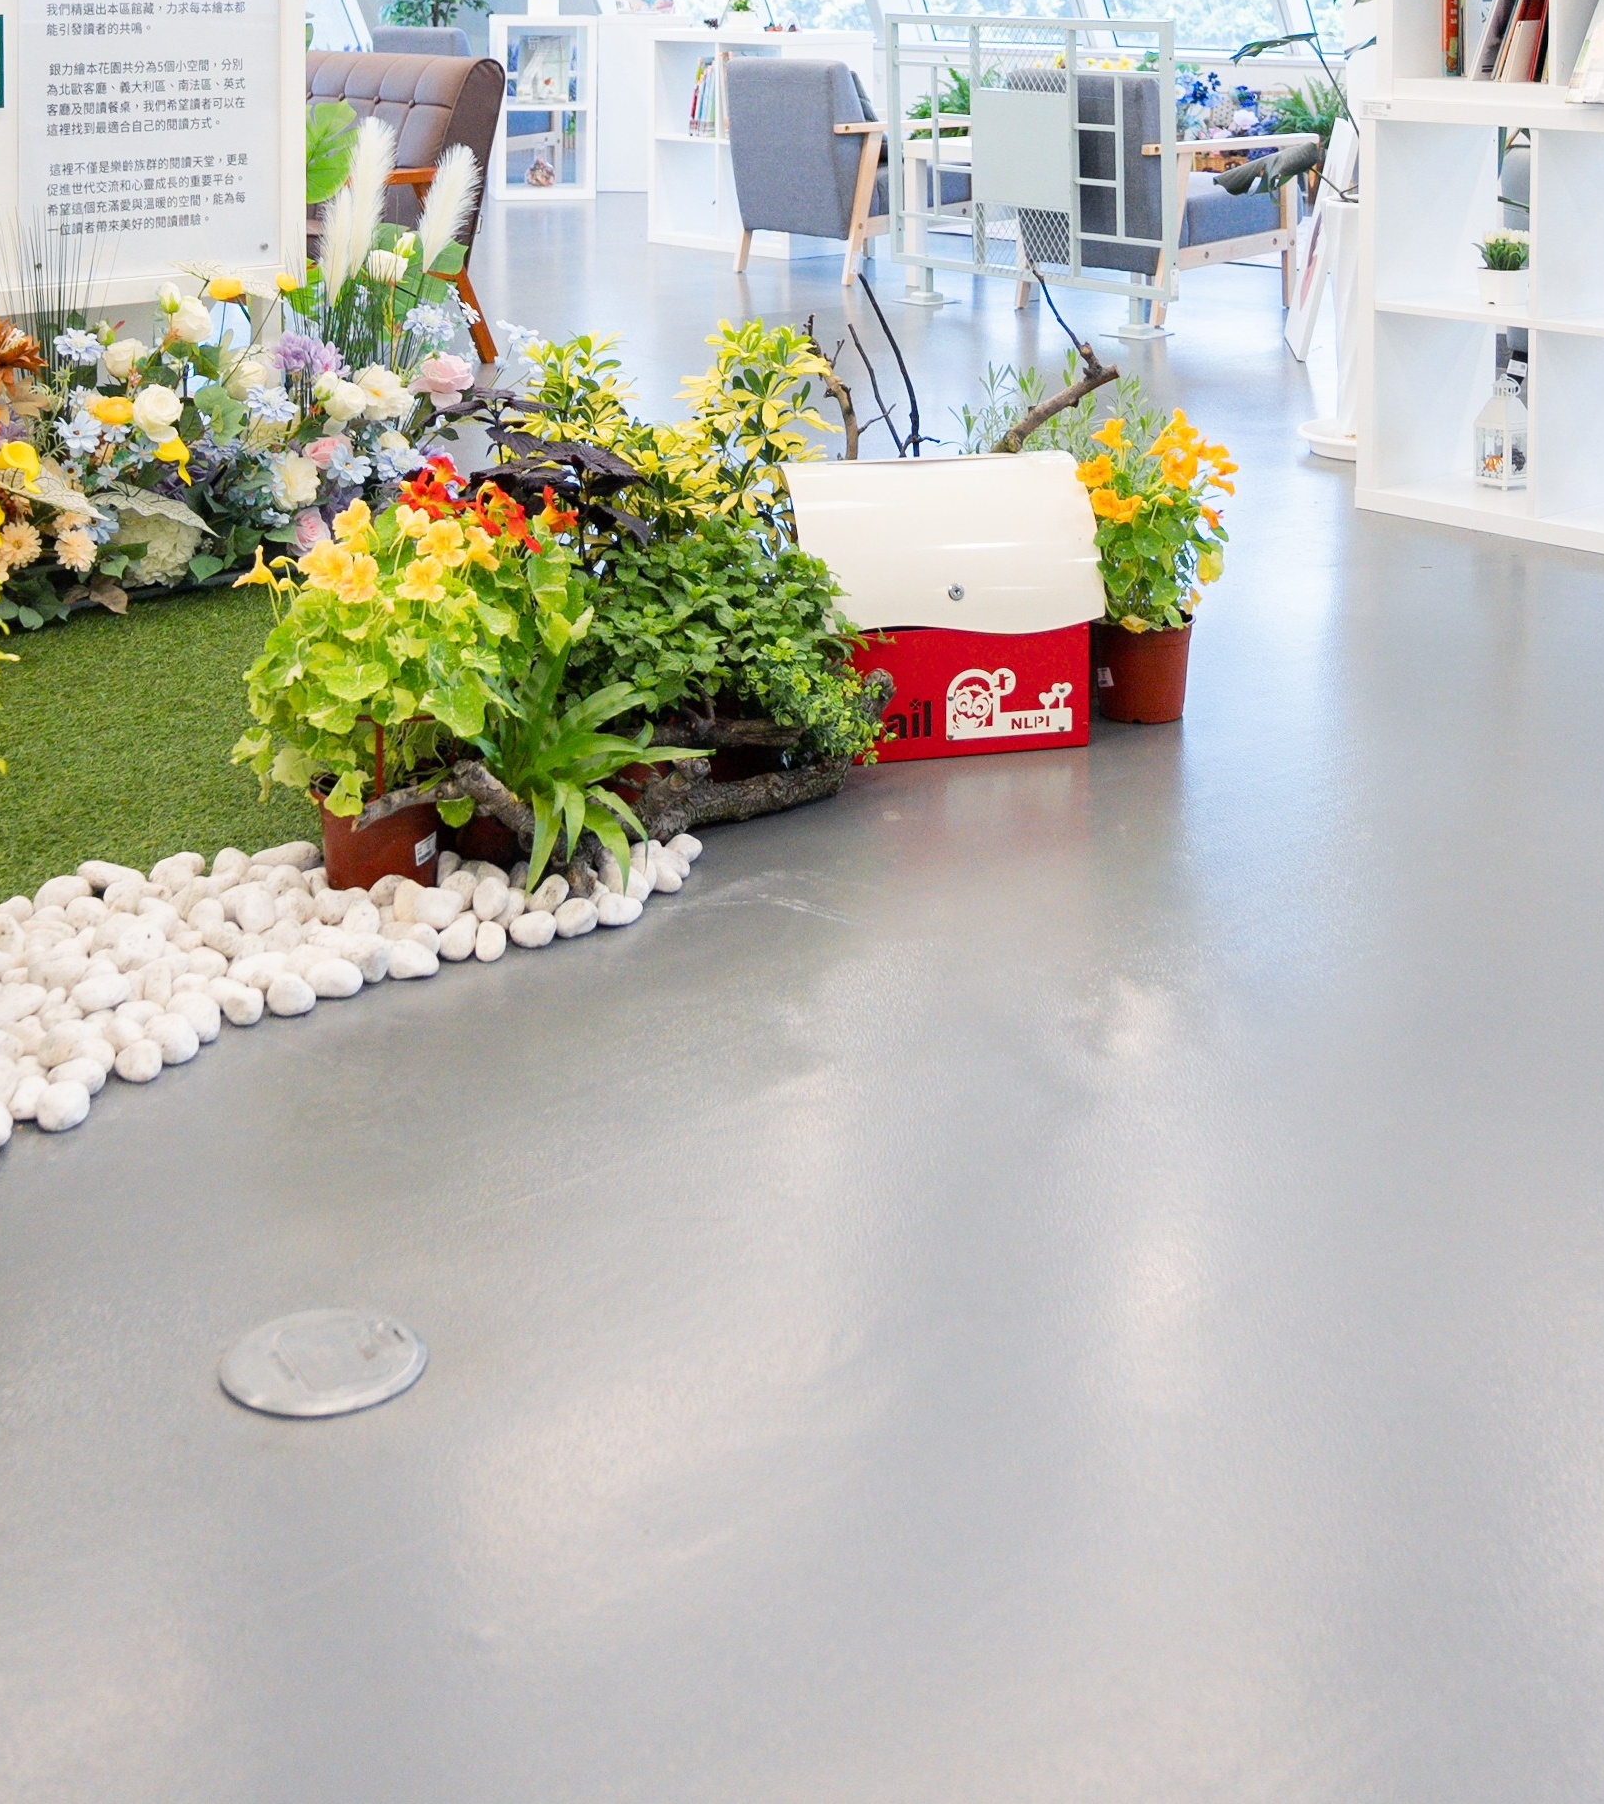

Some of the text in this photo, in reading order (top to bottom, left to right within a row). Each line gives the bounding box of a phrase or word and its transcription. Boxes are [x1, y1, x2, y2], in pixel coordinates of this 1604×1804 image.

[46, 22, 152, 36] 能引發讀者的共鳴。
[874, 699, 932, 741] ail
[1011, 715, 1050, 730] NLPI
